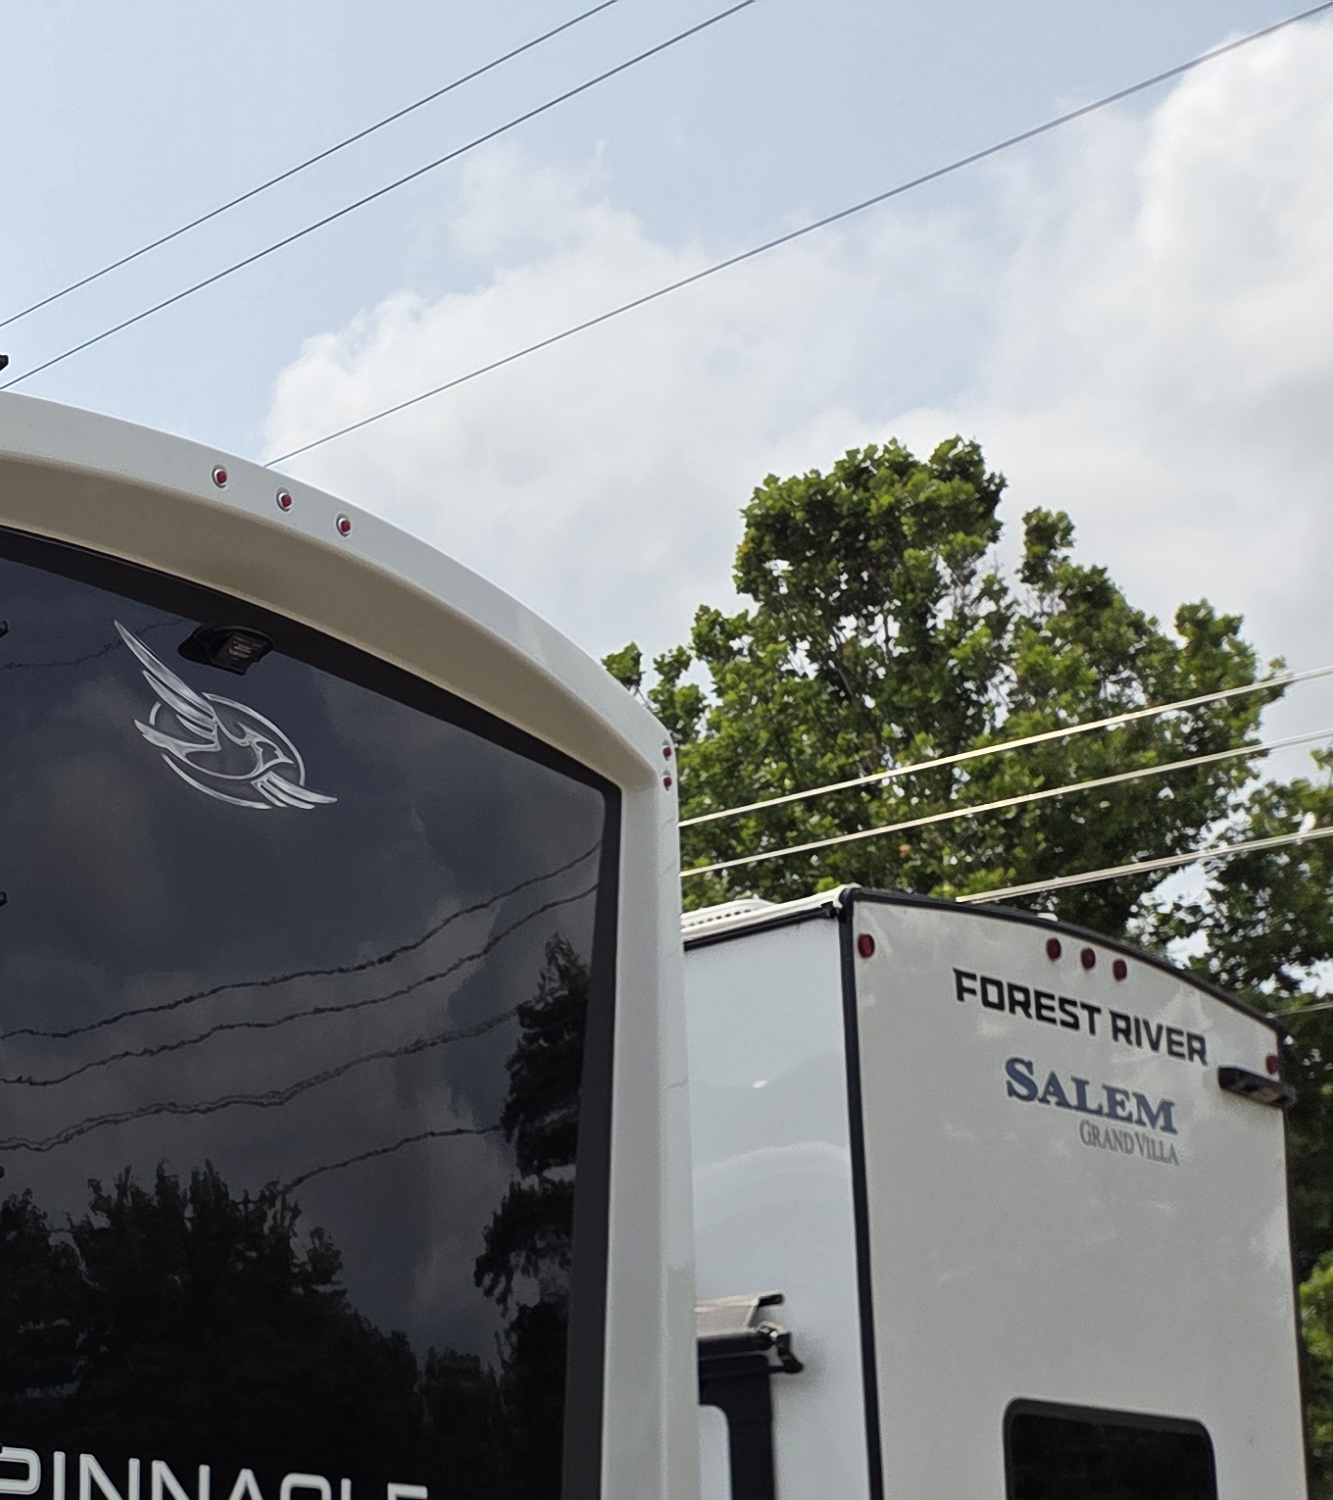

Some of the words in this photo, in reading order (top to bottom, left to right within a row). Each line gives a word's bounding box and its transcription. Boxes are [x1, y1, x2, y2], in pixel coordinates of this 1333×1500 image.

[952, 967, 1102, 1036] FOREST
[1109, 1008, 1208, 1067] RIVER
[1004, 1056, 1179, 1136] SALEM
[1079, 1119, 1135, 1156] GRAND
[1134, 1131, 1180, 1167] VILLA
